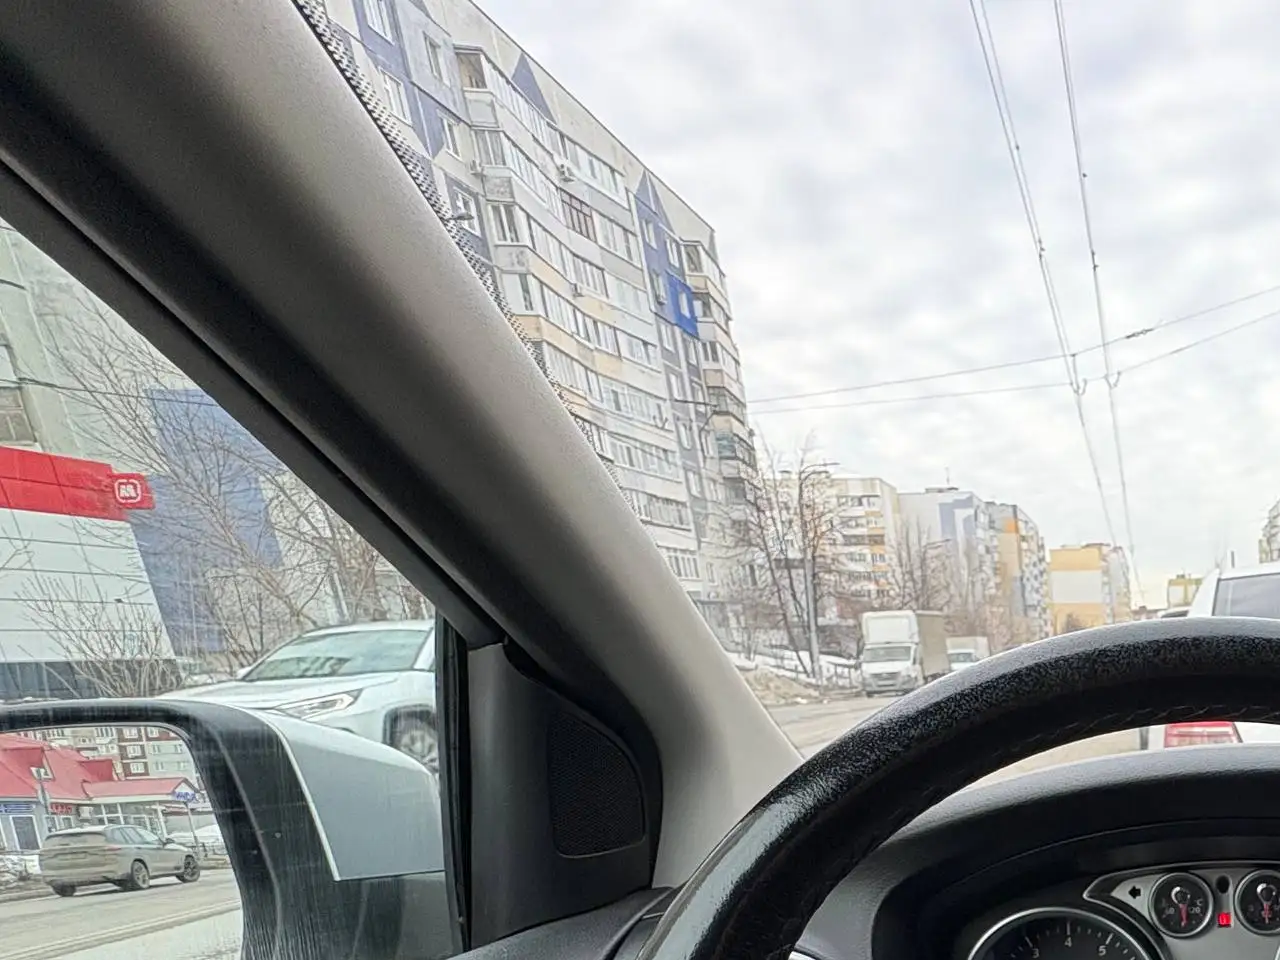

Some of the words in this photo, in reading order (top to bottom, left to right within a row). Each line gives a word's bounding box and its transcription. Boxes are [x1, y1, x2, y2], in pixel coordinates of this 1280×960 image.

[1064, 937, 1072, 947] 4
[1032, 949, 1040, 959] 3
[1099, 946, 1106, 956] 5
